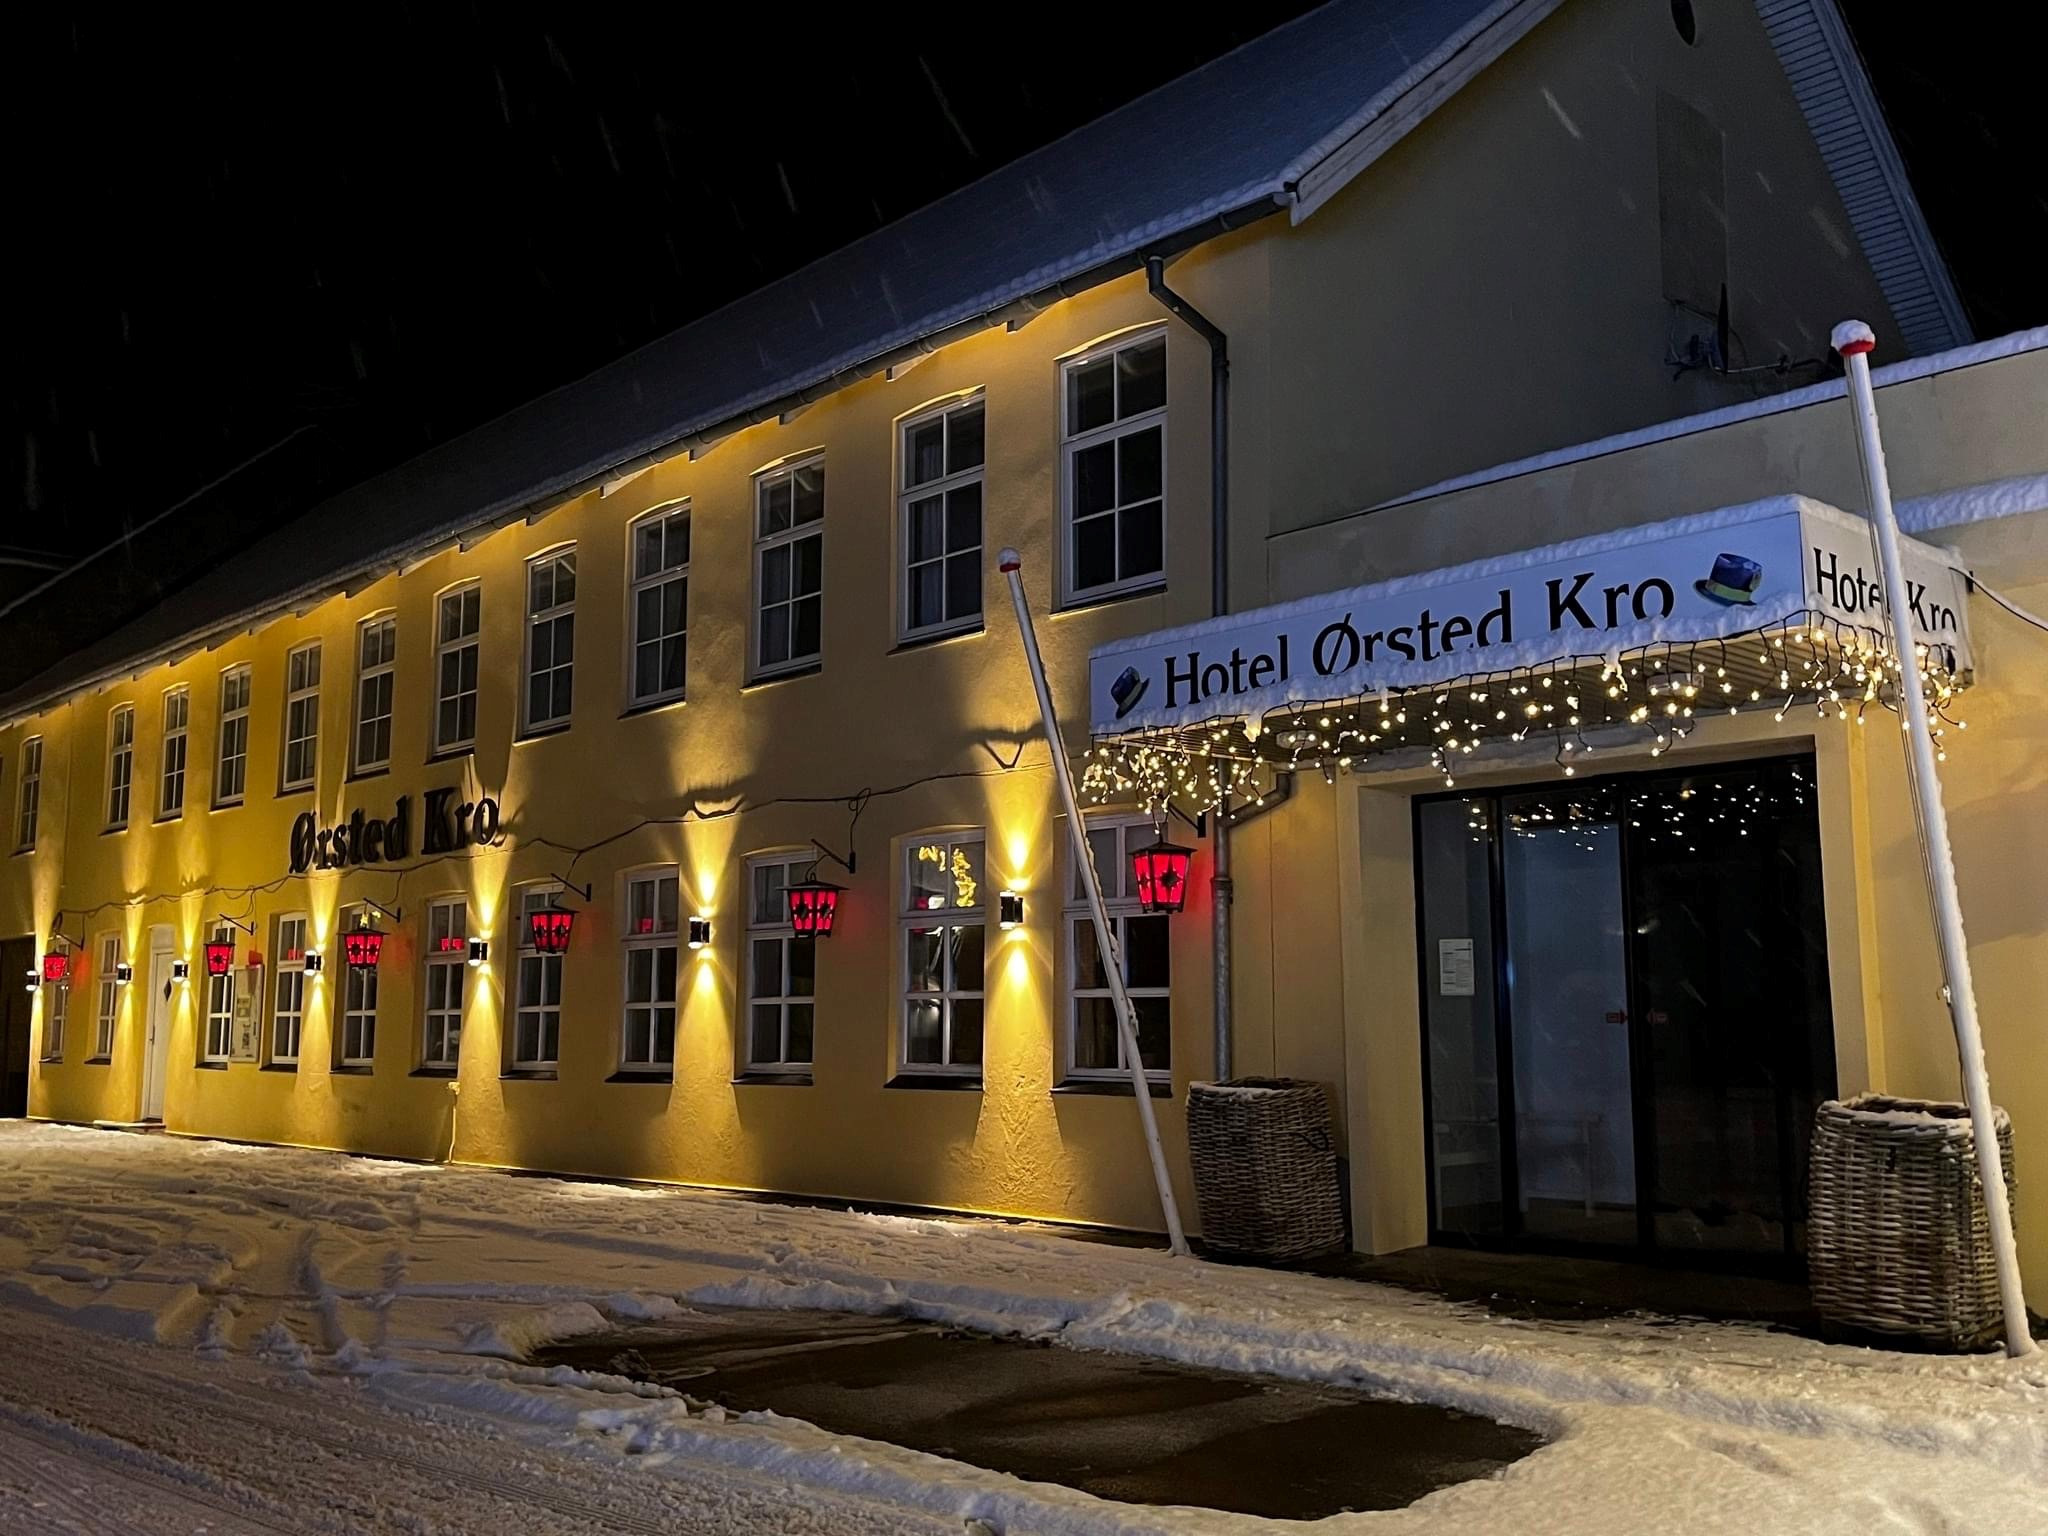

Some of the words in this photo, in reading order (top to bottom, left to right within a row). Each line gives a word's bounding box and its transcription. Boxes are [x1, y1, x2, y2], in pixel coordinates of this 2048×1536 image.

[1164, 634, 1288, 709] Hotel
[1312, 589, 1513, 676] Ørsted
[1545, 562, 1674, 631] Kro
[1905, 580, 1957, 633] Kro
[289, 794, 408, 874] Ørsted
[421, 786, 499, 855] Kro
